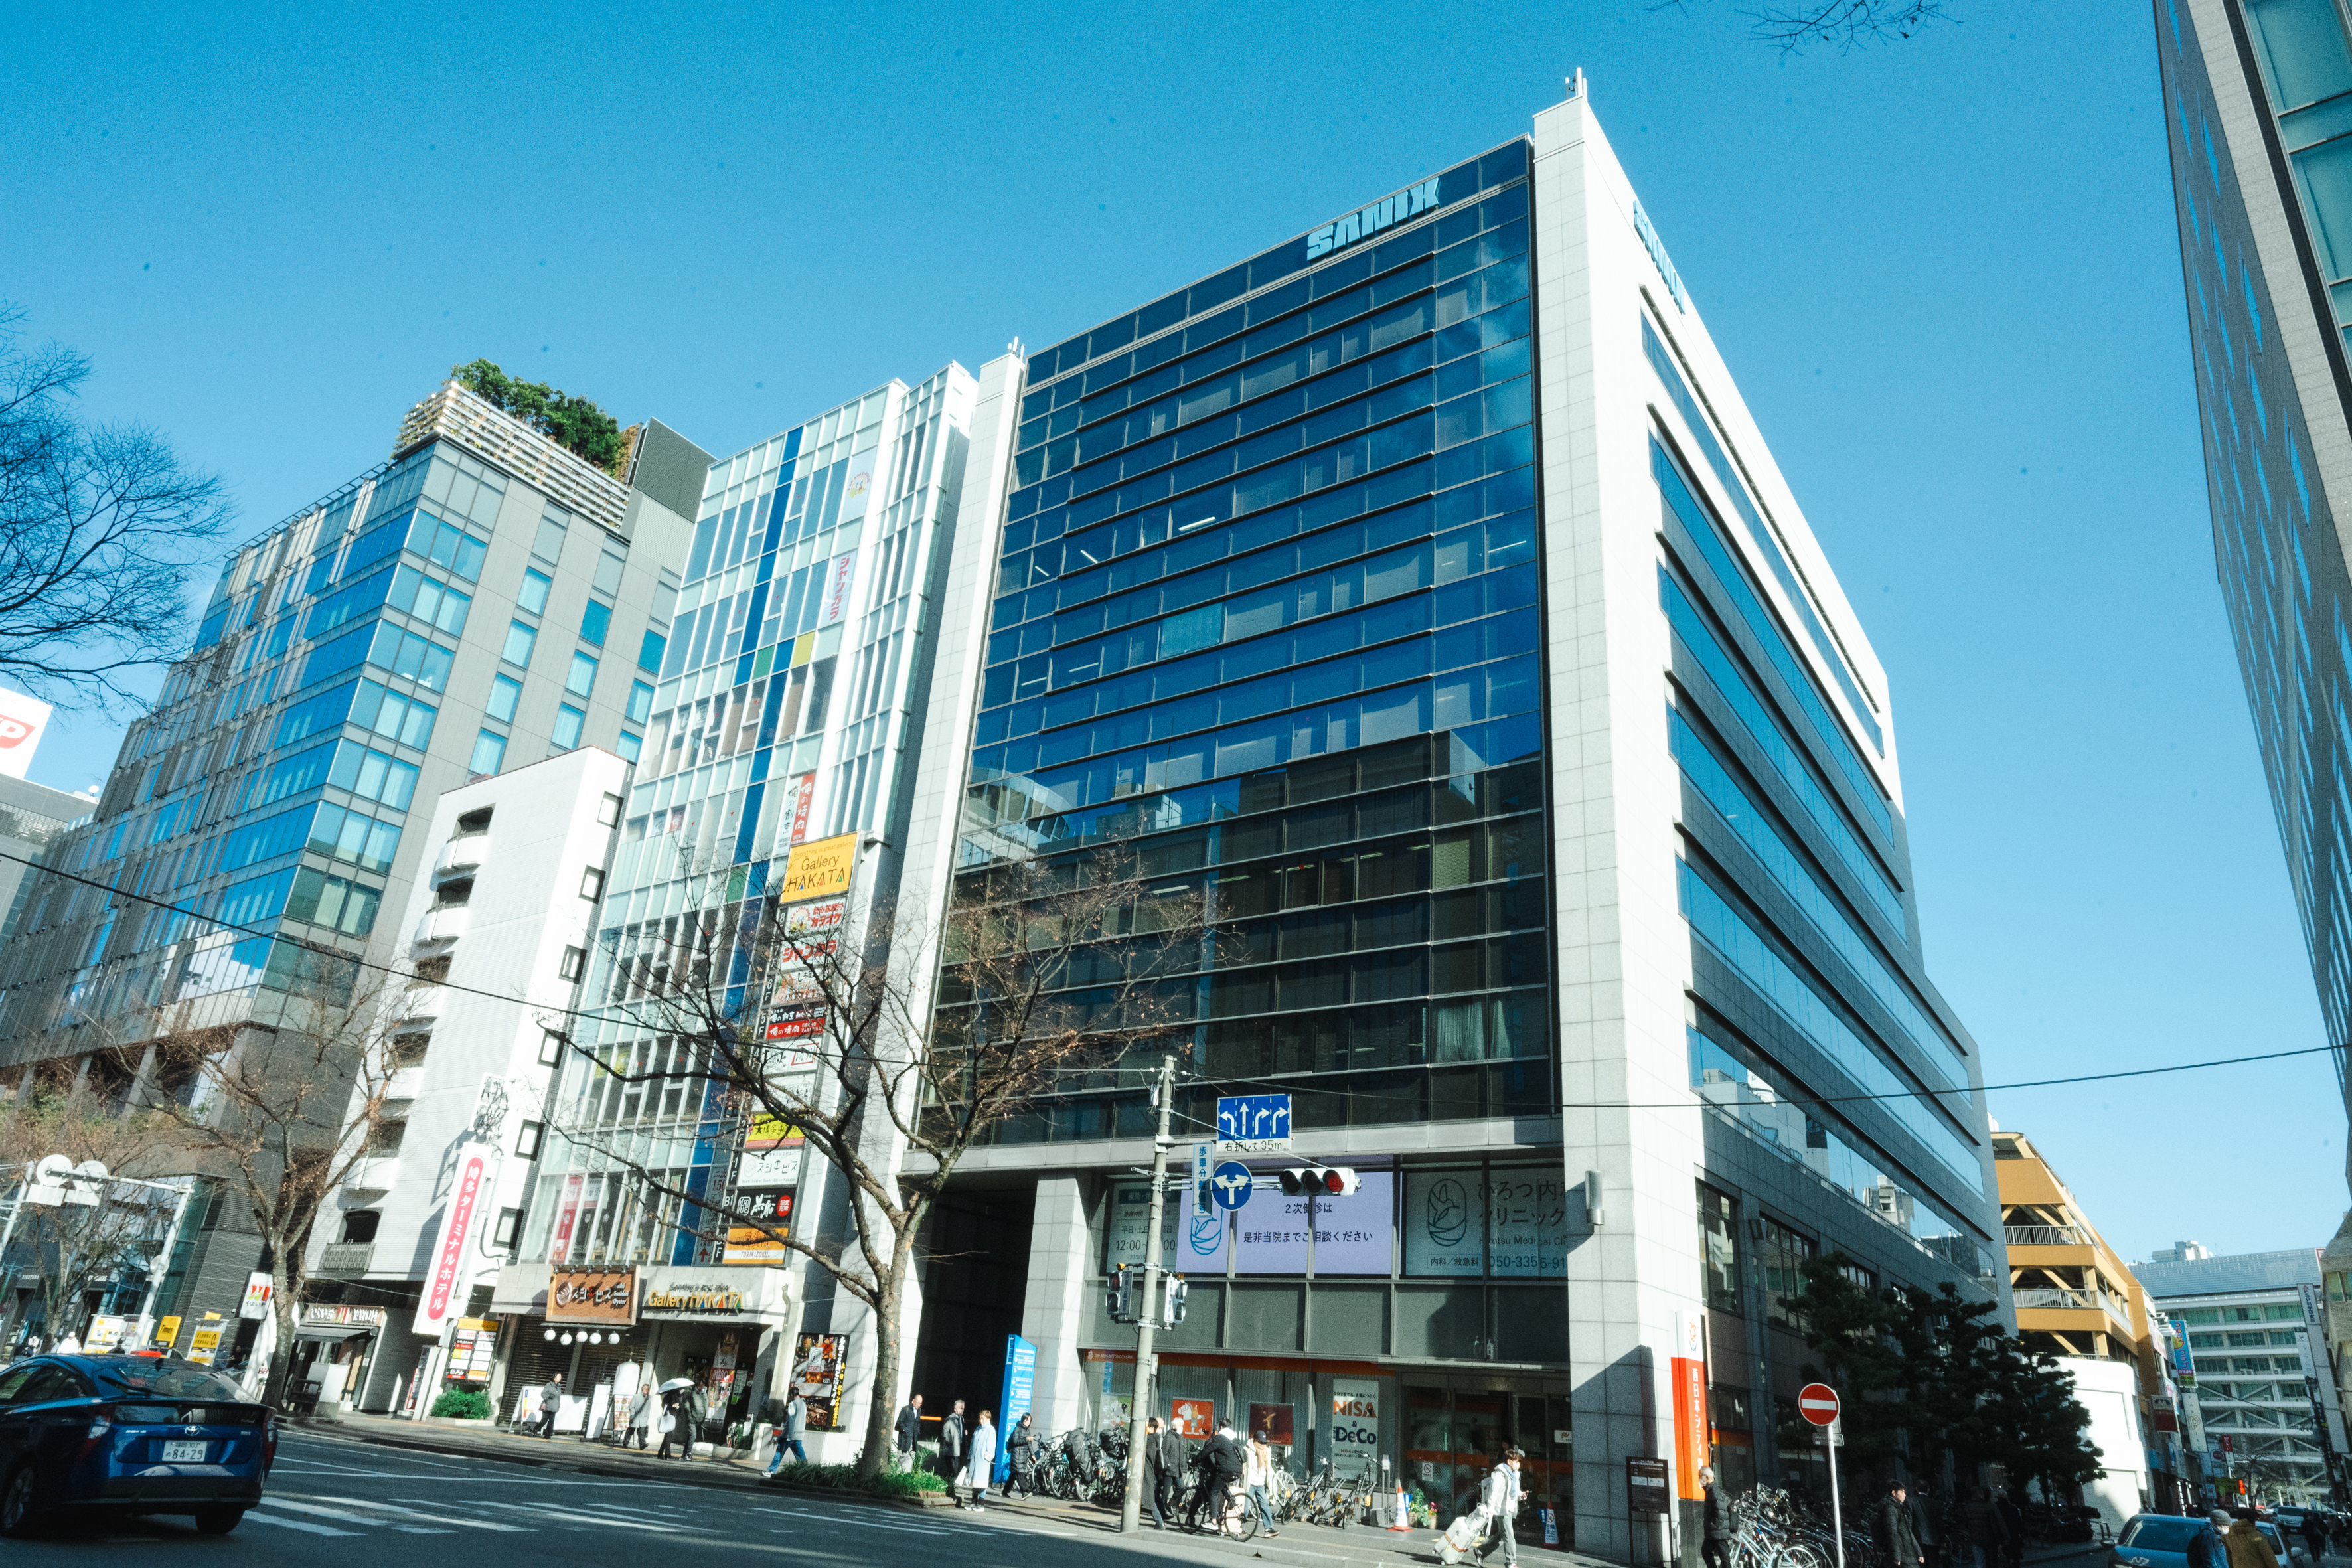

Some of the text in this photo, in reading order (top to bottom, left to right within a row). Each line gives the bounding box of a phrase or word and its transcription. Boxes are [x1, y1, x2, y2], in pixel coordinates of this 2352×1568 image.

[1306, 177, 1440, 261] SANIX
[795, 781, 813, 830] 俺の焼肉
[794, 848, 818, 858] Everything
[823, 844, 836, 853] great
[836, 840, 852, 850] gallery
[801, 855, 840, 871] Gallery
[787, 867, 846, 892] HAKATA
[810, 913, 842, 928] カラオケ
[783, 939, 837, 963] ジャンカラ
[770, 1010, 795, 1023] 俺の割烹
[769, 1024, 800, 1036] 俺の焼肉
[1478, 1180, 1565, 1202] ひろつ内
[431, 1166, 480, 1310] 博多ターミナルホテル
[1479, 1236, 1511, 1245] Hrotsu
[1554, 1237, 1567, 1246] Cli
[1489, 1255, 1567, 1269] 050-3355-91
[648, 1290, 744, 1311] Gallery HAKATA
[1334, 1399, 1377, 1418] NISA
[1333, 1426, 1377, 1445] iDeCo
[1692, 1368, 1704, 1489] 西日本シティ銀
[172, 1449, 204, 1460] 84-29
